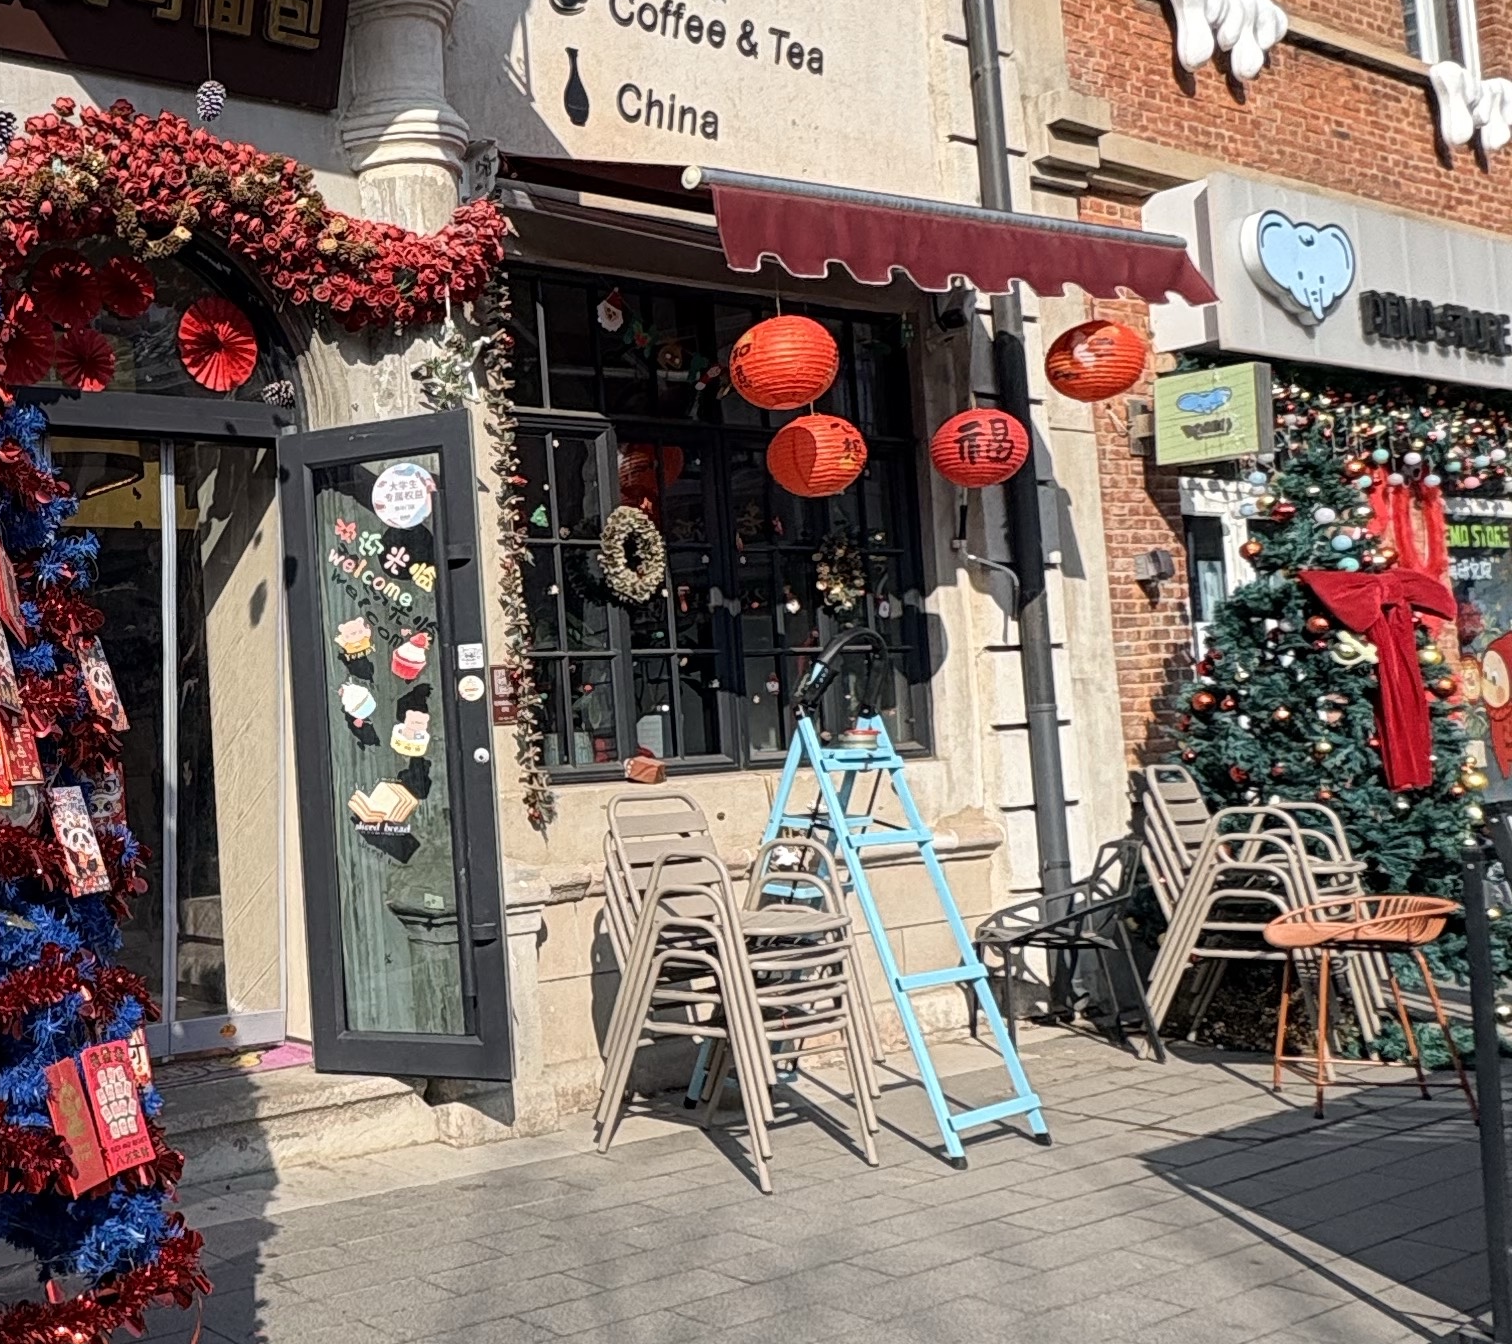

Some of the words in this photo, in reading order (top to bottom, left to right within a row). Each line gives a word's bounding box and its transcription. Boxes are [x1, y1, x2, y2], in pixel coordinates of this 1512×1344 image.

[737, 20, 758, 58] &
[769, 28, 824, 75] Tea
[617, 84, 719, 139] China
[954, 418, 1015, 465] 福
[389, 479, 418, 491] 大学生
[328, 548, 413, 607] welcome
[384, 822, 411, 833] bread
